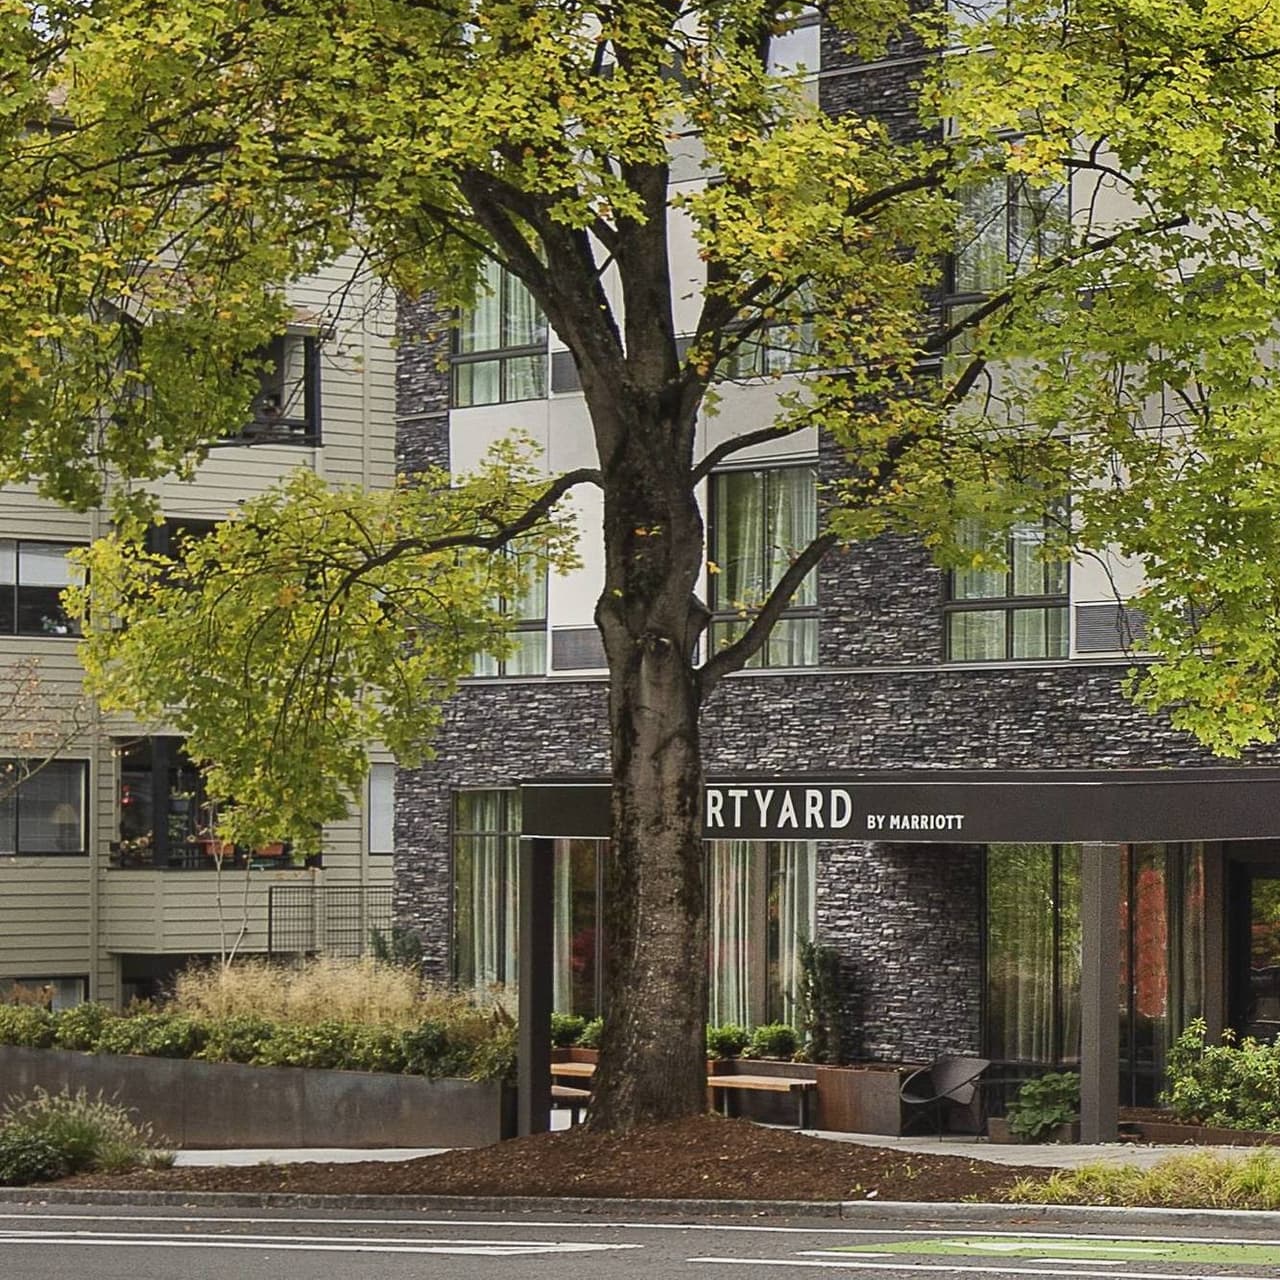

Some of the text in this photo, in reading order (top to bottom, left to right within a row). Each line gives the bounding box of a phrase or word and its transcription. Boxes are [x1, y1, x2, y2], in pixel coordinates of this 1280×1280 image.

[706, 789, 965, 830] RTYARD BY MARRIOTT
